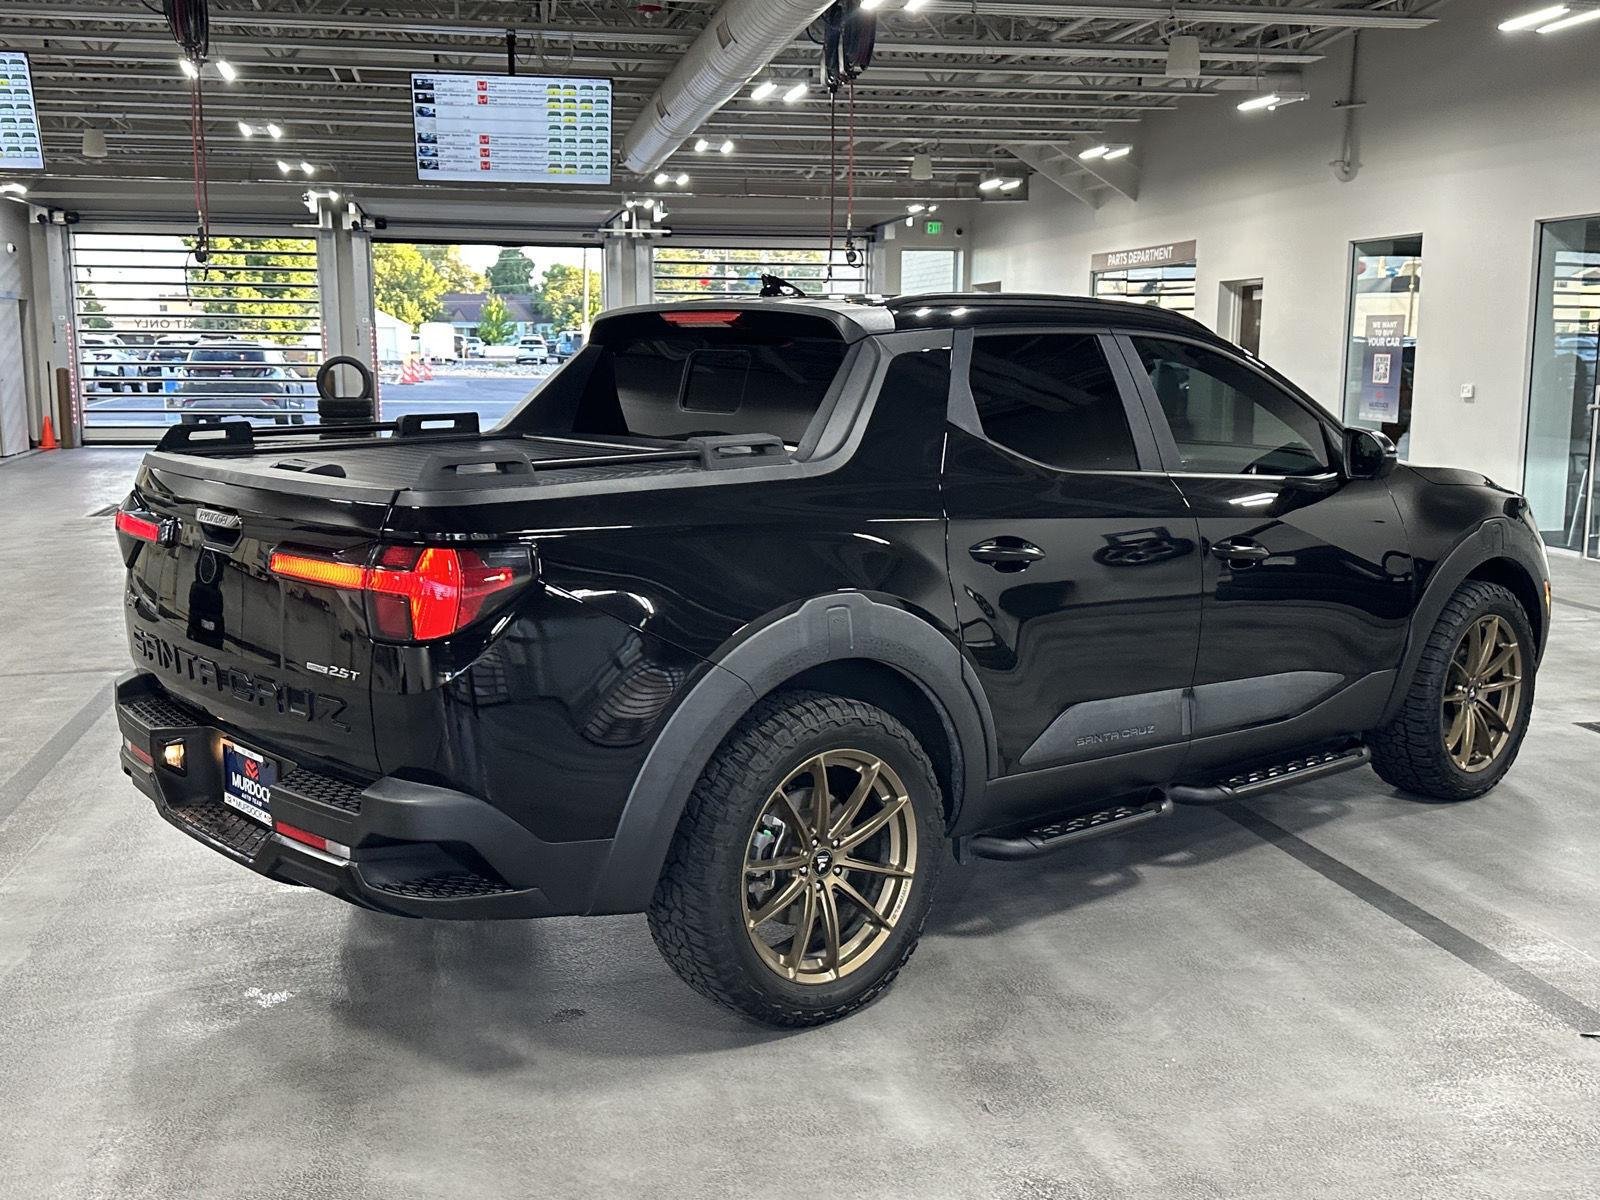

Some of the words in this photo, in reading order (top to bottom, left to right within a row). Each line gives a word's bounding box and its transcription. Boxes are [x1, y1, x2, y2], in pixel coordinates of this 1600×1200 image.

[1107, 252, 1128, 266] PARTS
[1128, 246, 1173, 264] DEPARTMENT
[1368, 336, 1385, 347] YOUR
[1386, 336, 1400, 347] CAR
[134, 625, 224, 692] SANTA
[228, 667, 351, 733] CRUZ
[1076, 732, 1120, 746] SANTA
[1121, 725, 1155, 738] CRUZ
